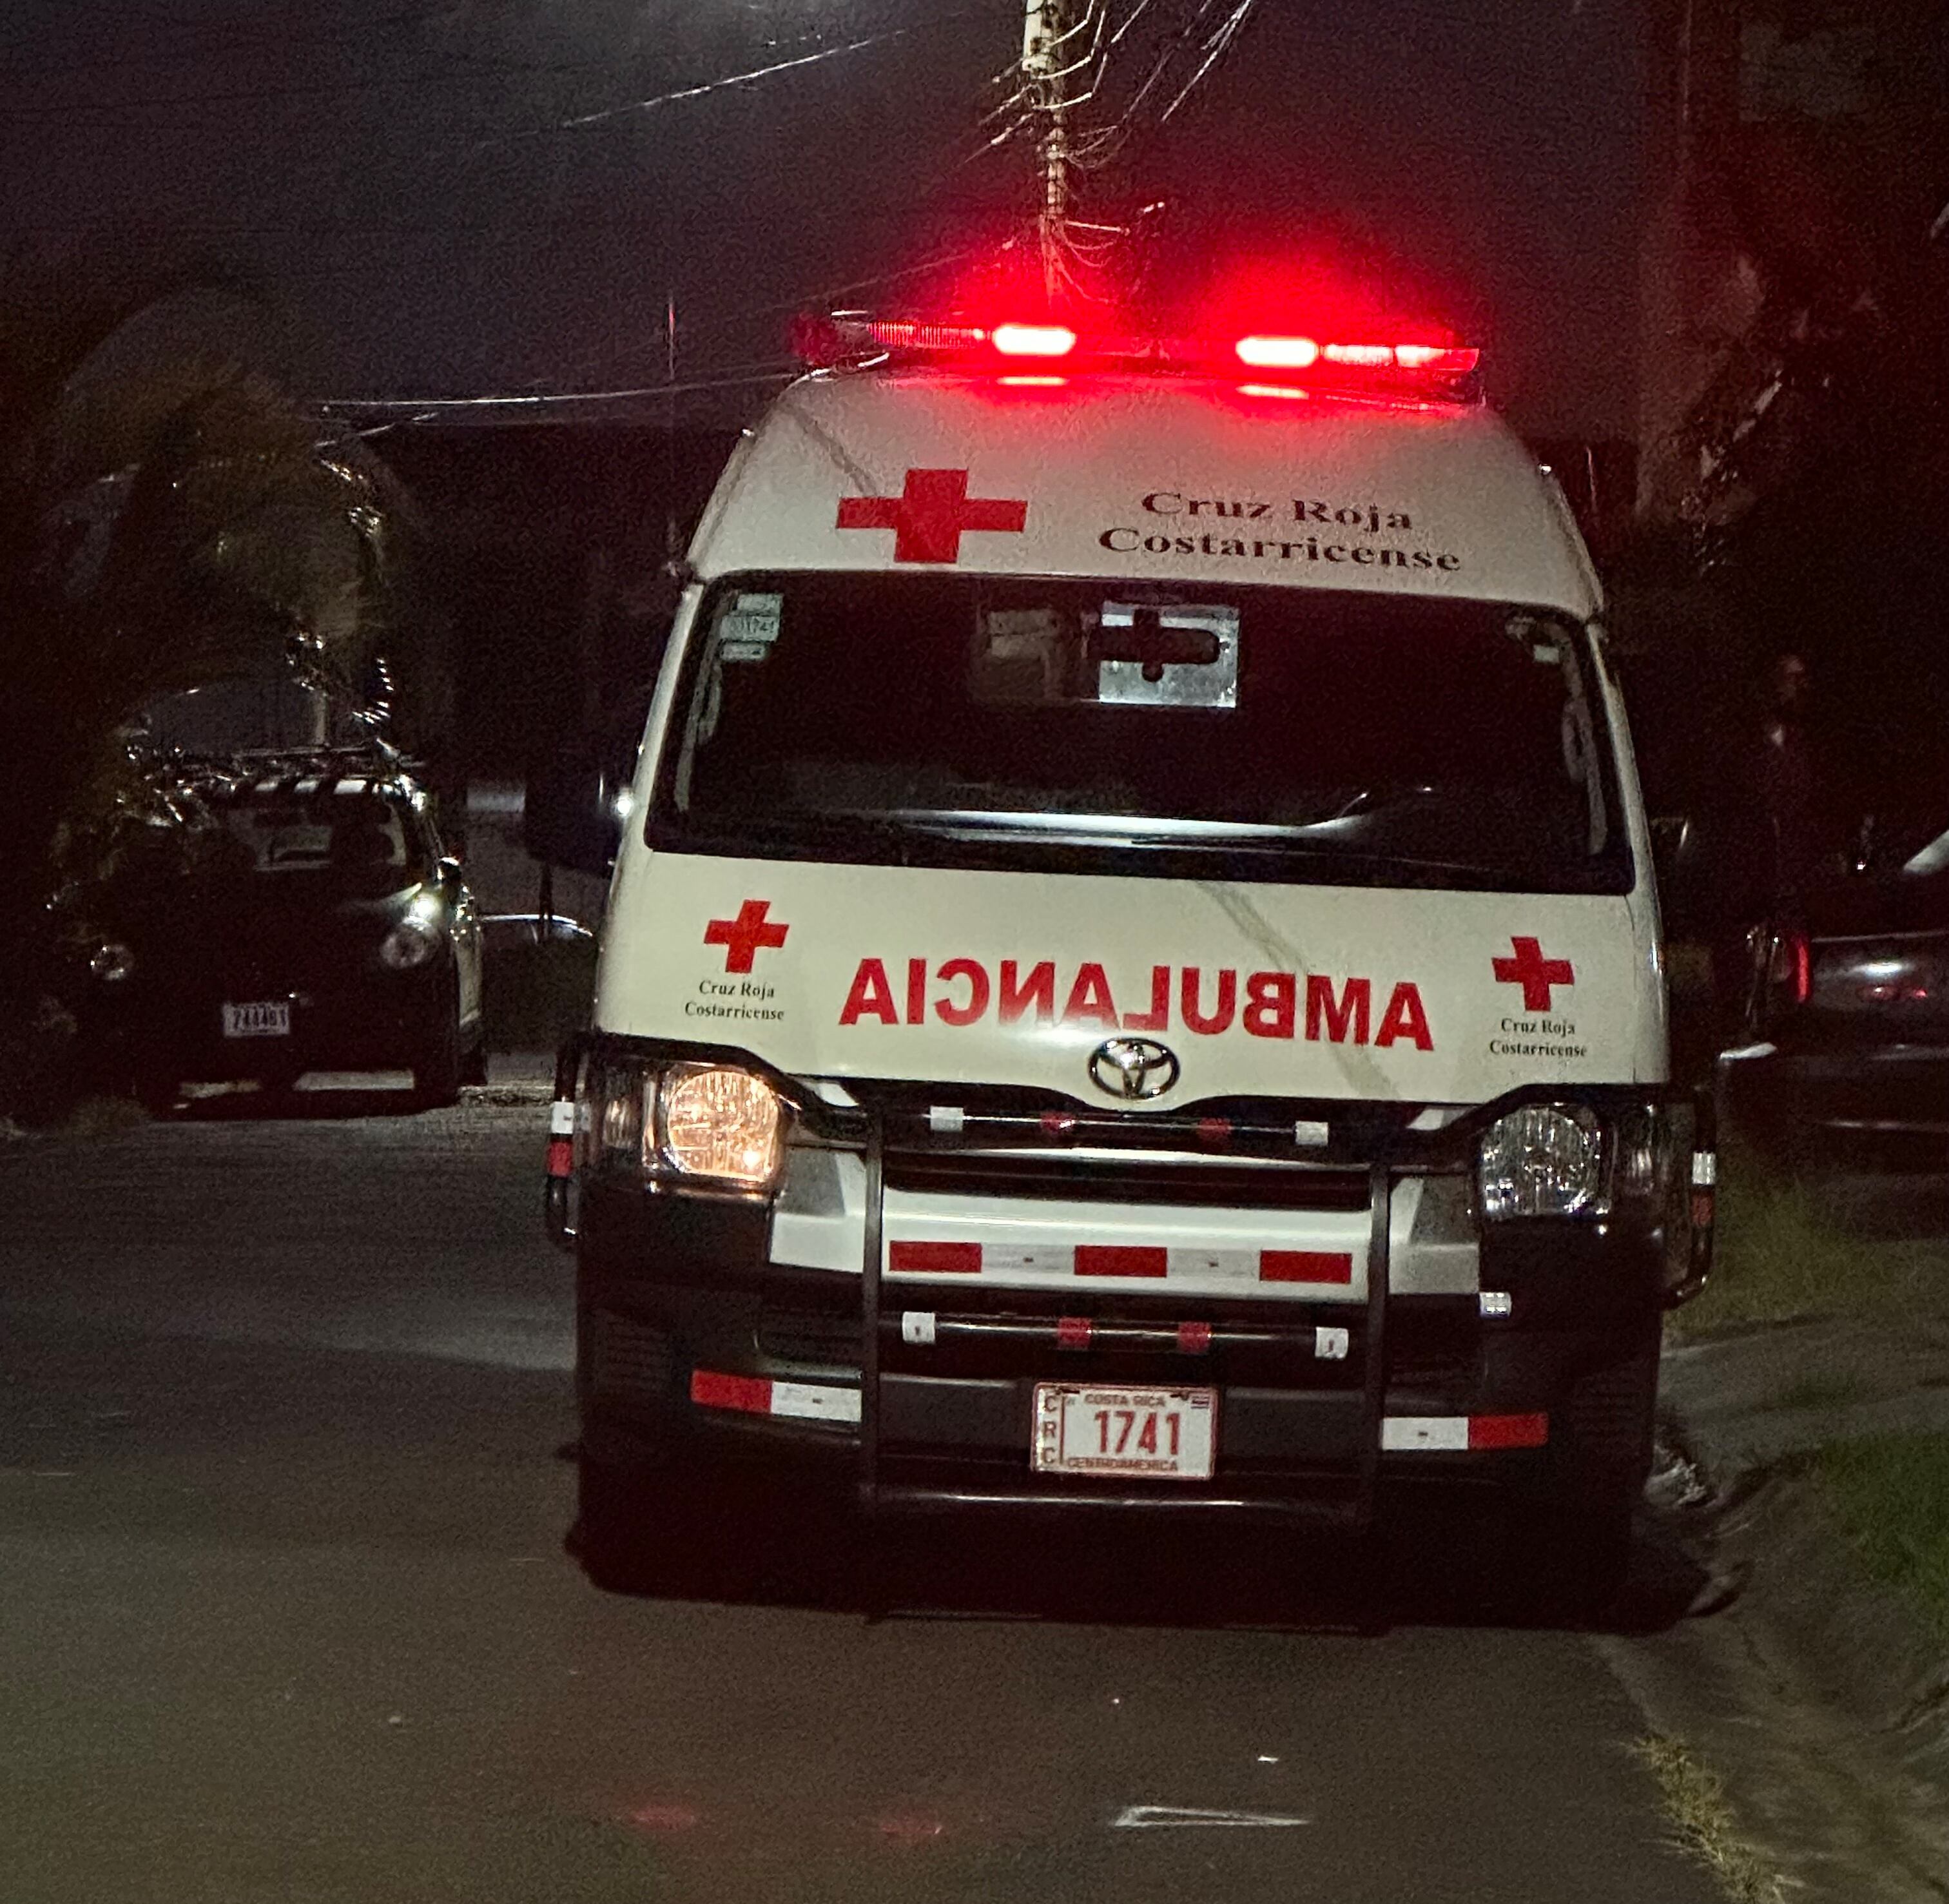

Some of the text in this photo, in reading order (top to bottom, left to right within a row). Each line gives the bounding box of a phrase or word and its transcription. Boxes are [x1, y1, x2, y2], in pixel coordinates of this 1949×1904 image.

[1140, 492, 1413, 533] Cruz Roja
[1098, 526, 1462, 572] Costarricense
[699, 979, 775, 1000] Cruz Roja
[684, 1000, 785, 1020] Costarricense
[1500, 1017, 1576, 1038] Cruz Roja
[1489, 1039, 1588, 1058] Costarricense
[1084, 1394, 1166, 1407] COSTA RICA
[1094, 1410, 1181, 1455] 1741
